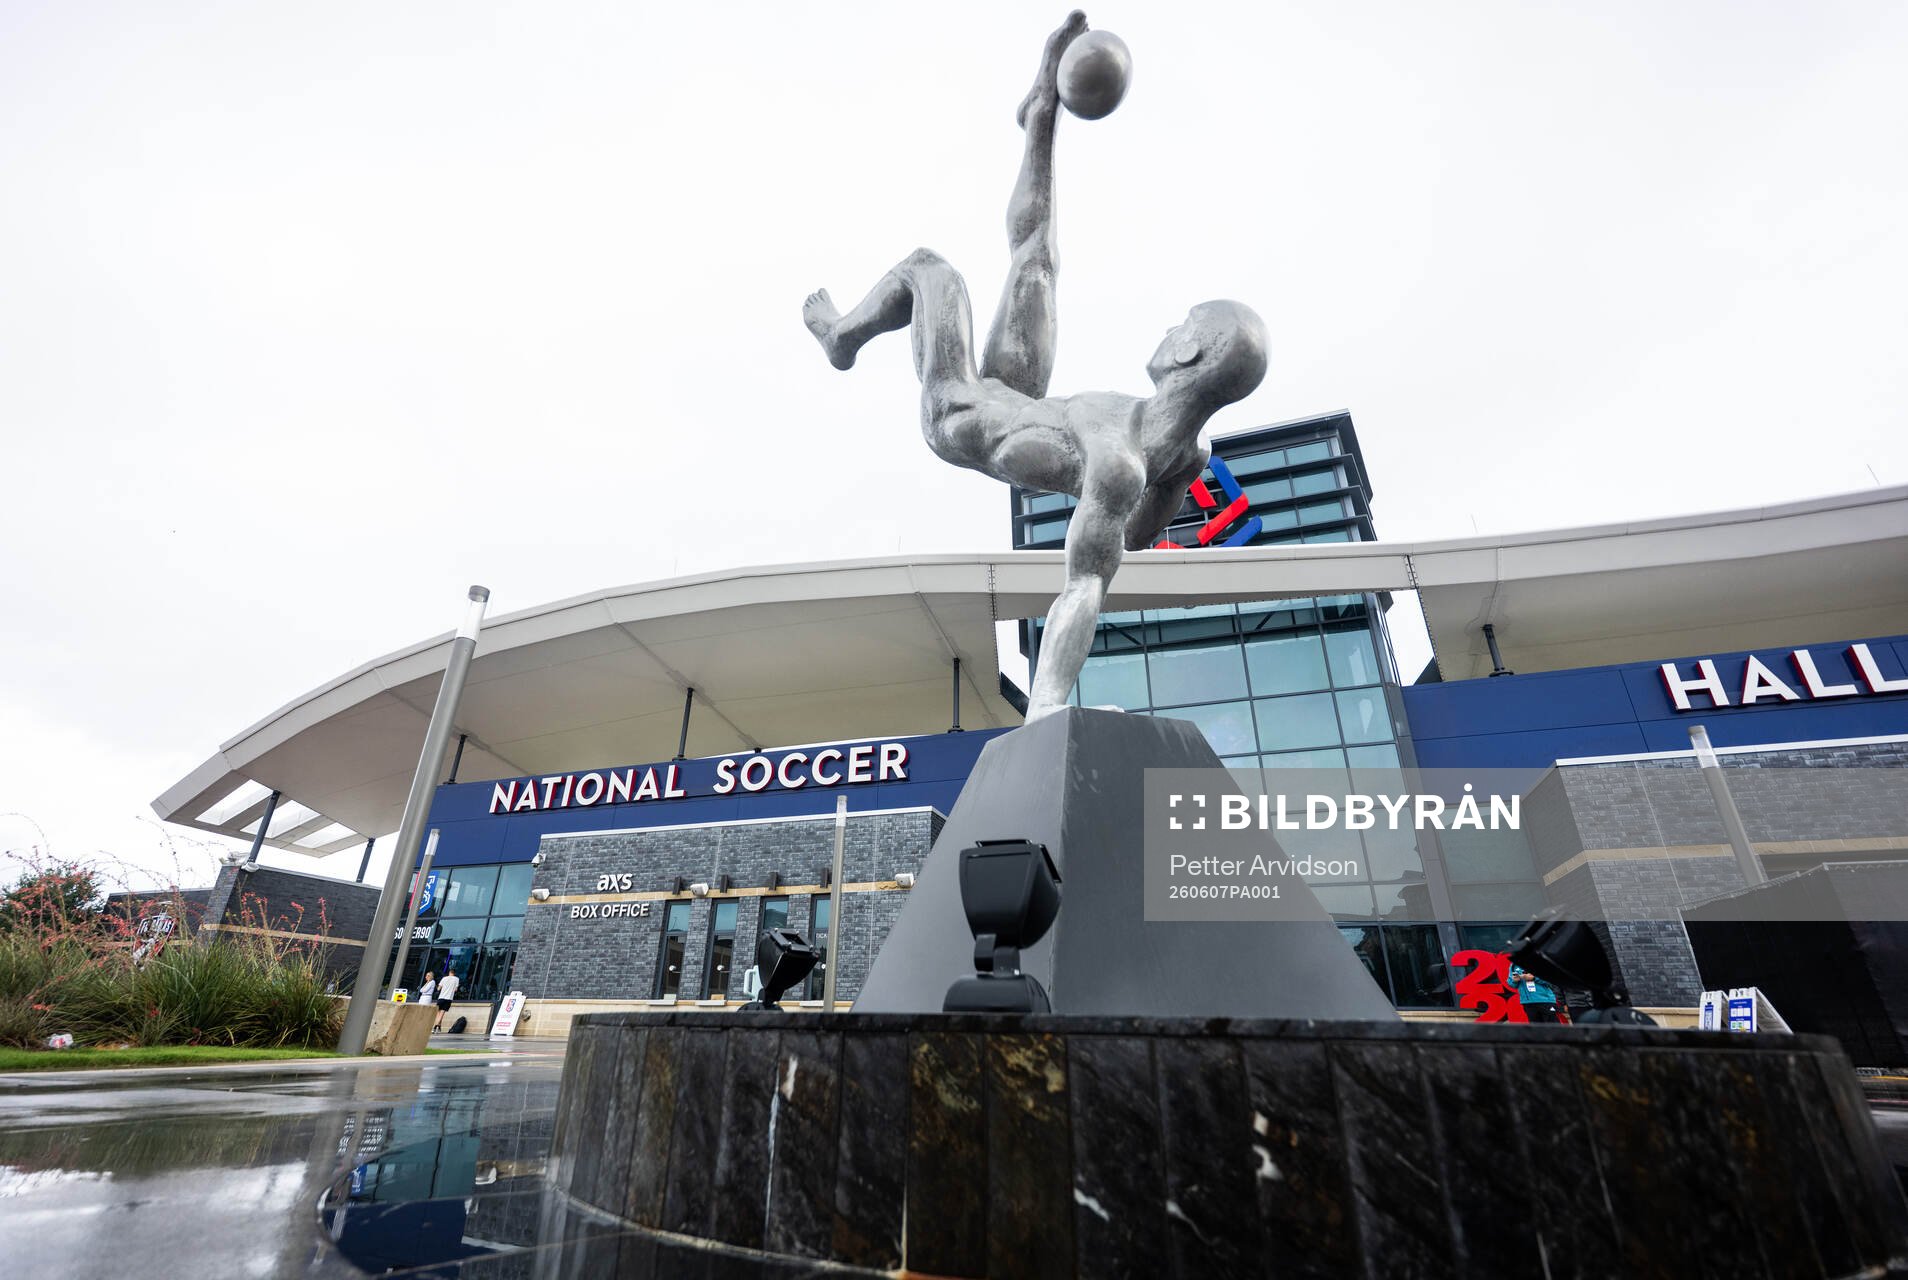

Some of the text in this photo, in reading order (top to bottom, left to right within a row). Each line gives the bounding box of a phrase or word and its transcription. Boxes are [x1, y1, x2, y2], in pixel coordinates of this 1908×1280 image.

[1659, 643, 1908, 710] HALL
[488, 743, 908, 814] NATIONAL SOCCER
[597, 873, 632, 893] axs
[571, 903, 649, 918] BOX OFFICE
